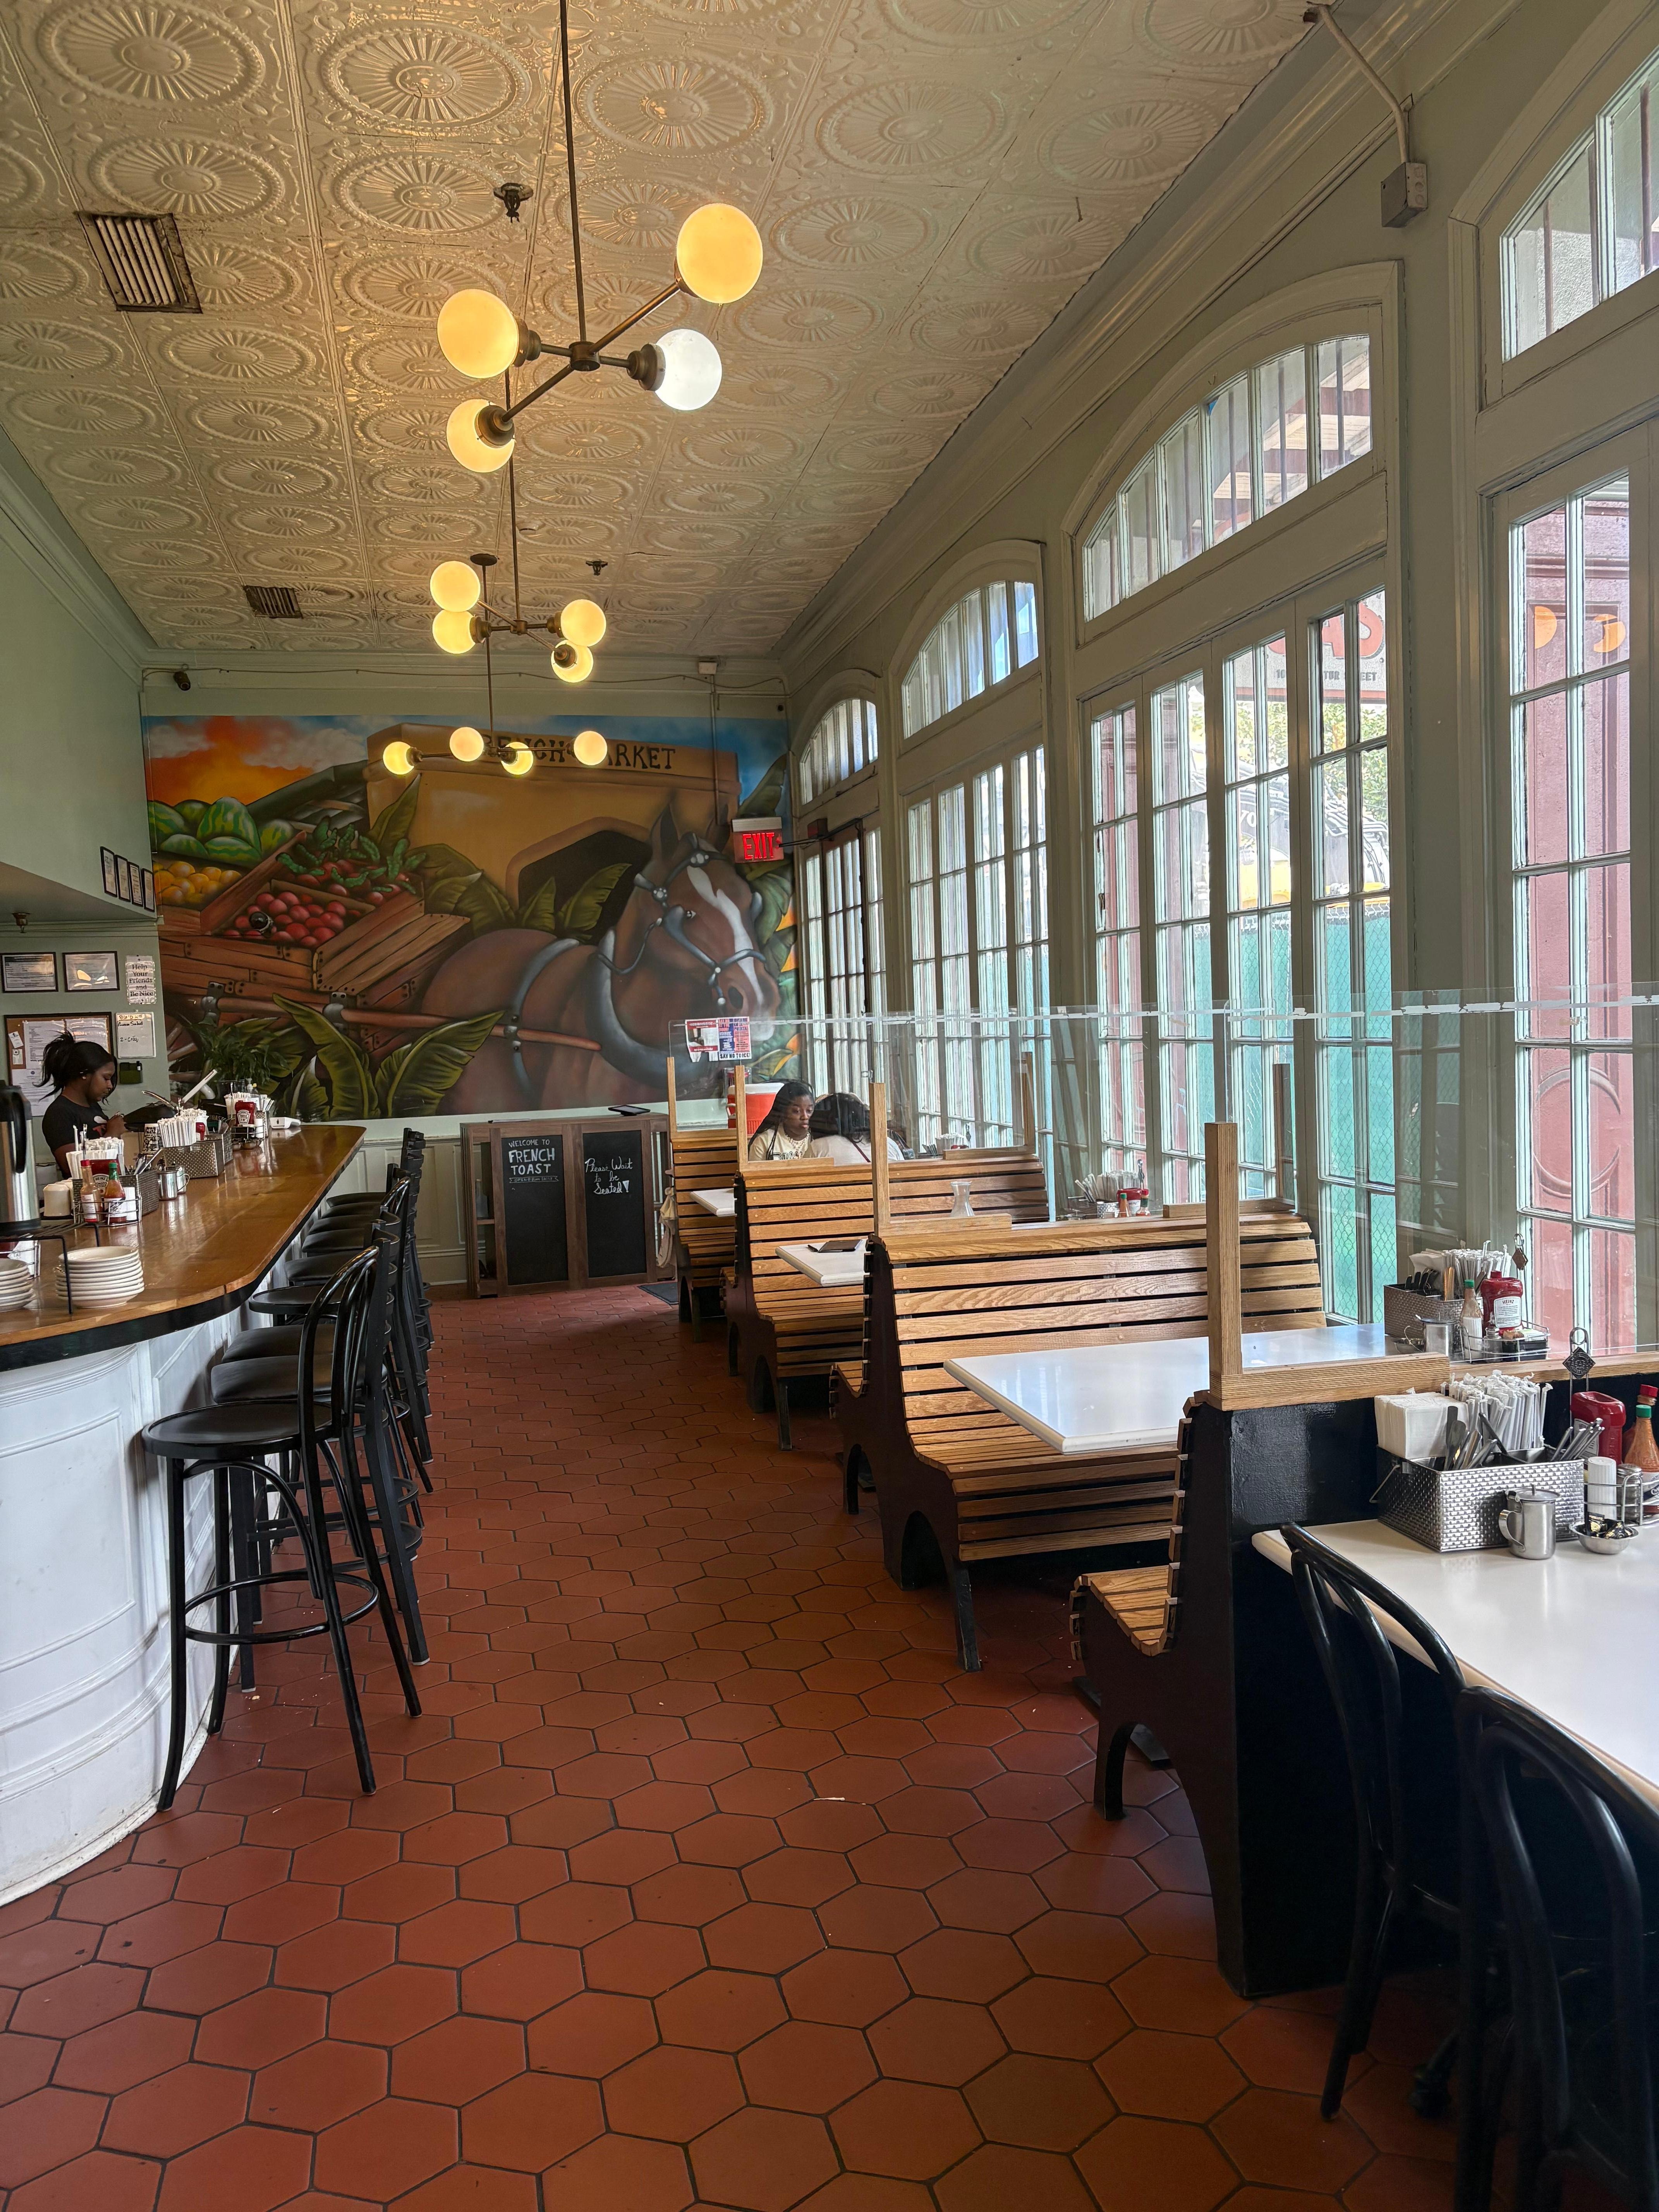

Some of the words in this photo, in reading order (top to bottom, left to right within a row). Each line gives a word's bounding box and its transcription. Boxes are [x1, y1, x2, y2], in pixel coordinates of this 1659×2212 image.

[743, 832, 775, 860] EXIT
[508, 1139, 539, 1148] WELCOME
[508, 1148, 555, 1163] FRENCH
[511, 1163, 551, 1175] TOAST
[585, 1158, 611, 1173] Please
[611, 1156, 633, 1170] Wait
[594, 1173, 601, 1183] to
[609, 1171, 620, 1182] be
